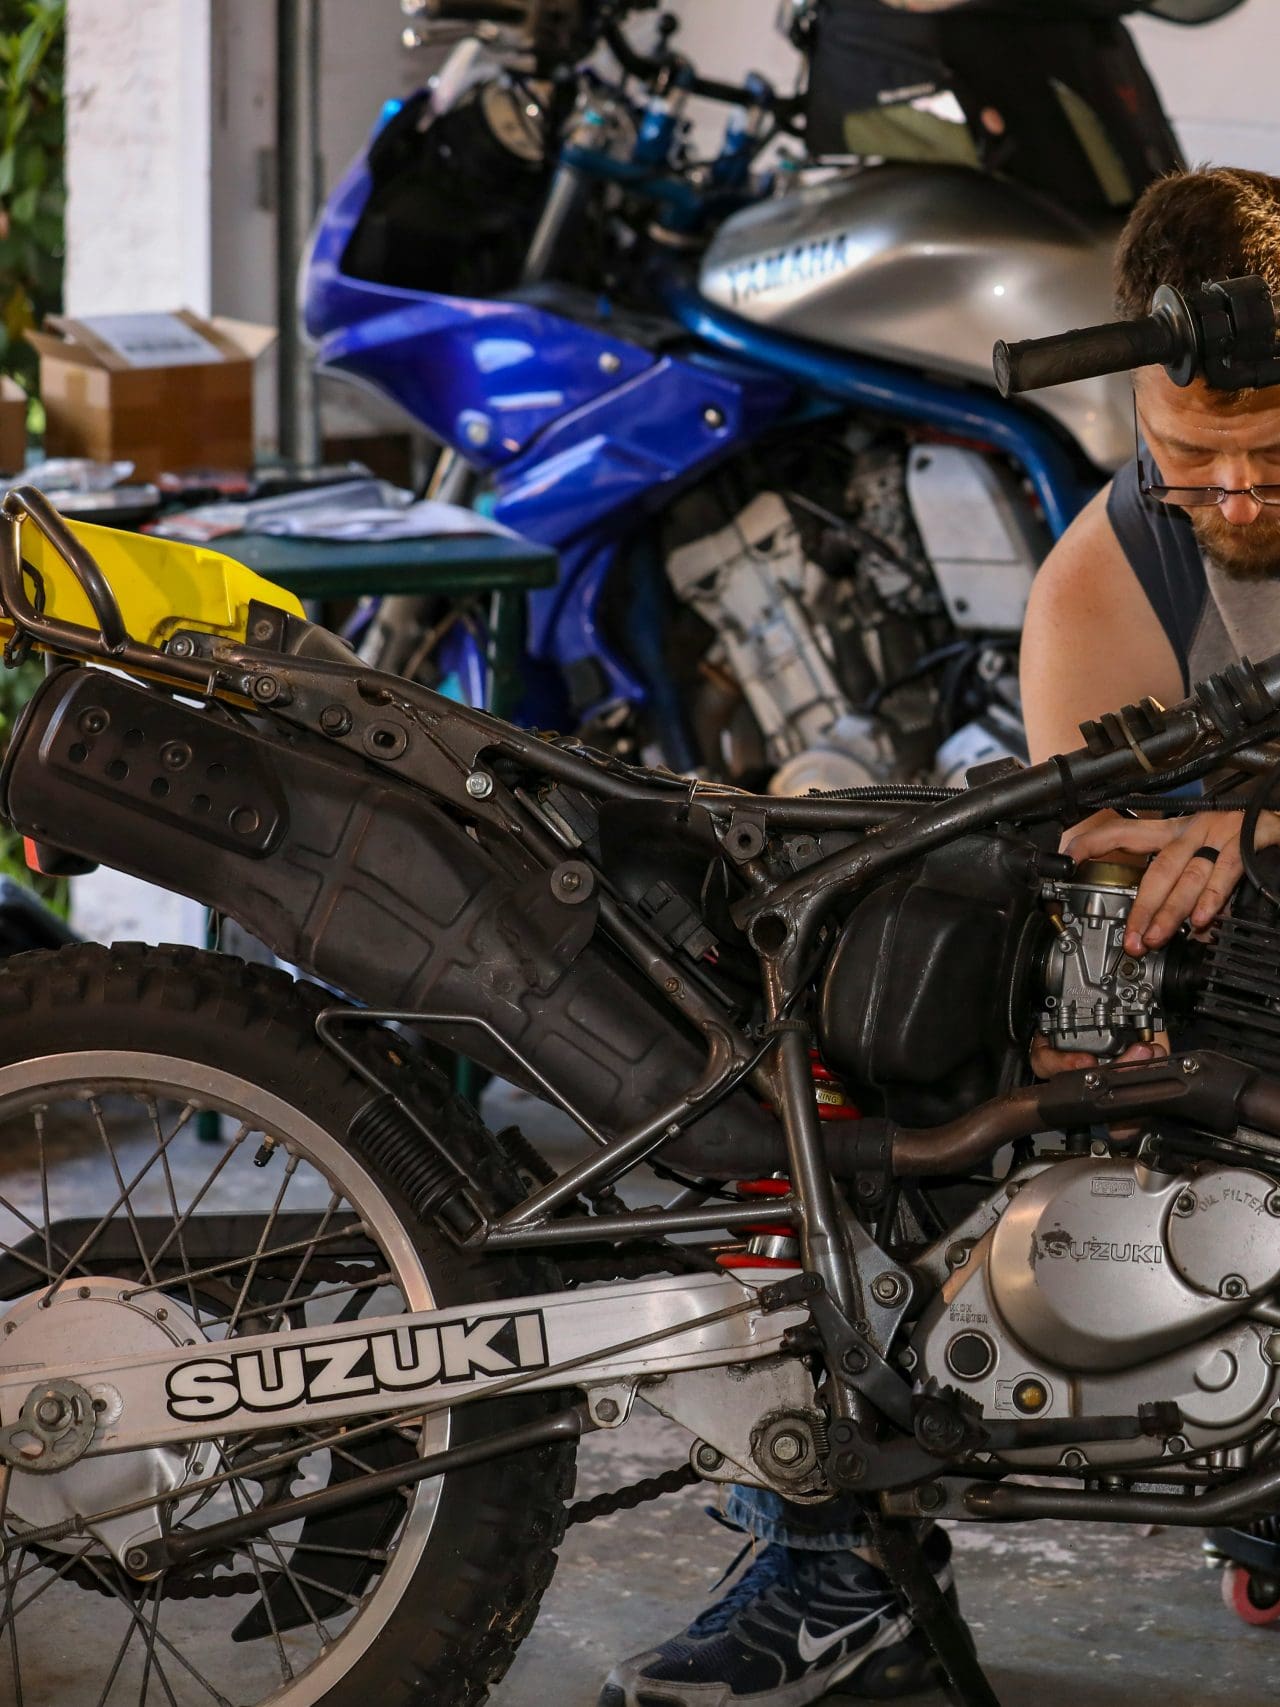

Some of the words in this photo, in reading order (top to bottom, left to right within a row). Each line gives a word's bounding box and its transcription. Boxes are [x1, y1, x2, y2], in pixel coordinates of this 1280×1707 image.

[726, 232, 848, 306] YAMAHA
[1198, 1194, 1220, 1212] OIL
[1222, 1187, 1265, 1217] FILTER
[1049, 1240, 1163, 1264] SUZUKI
[165, 1308, 549, 1422] SUZUKI
